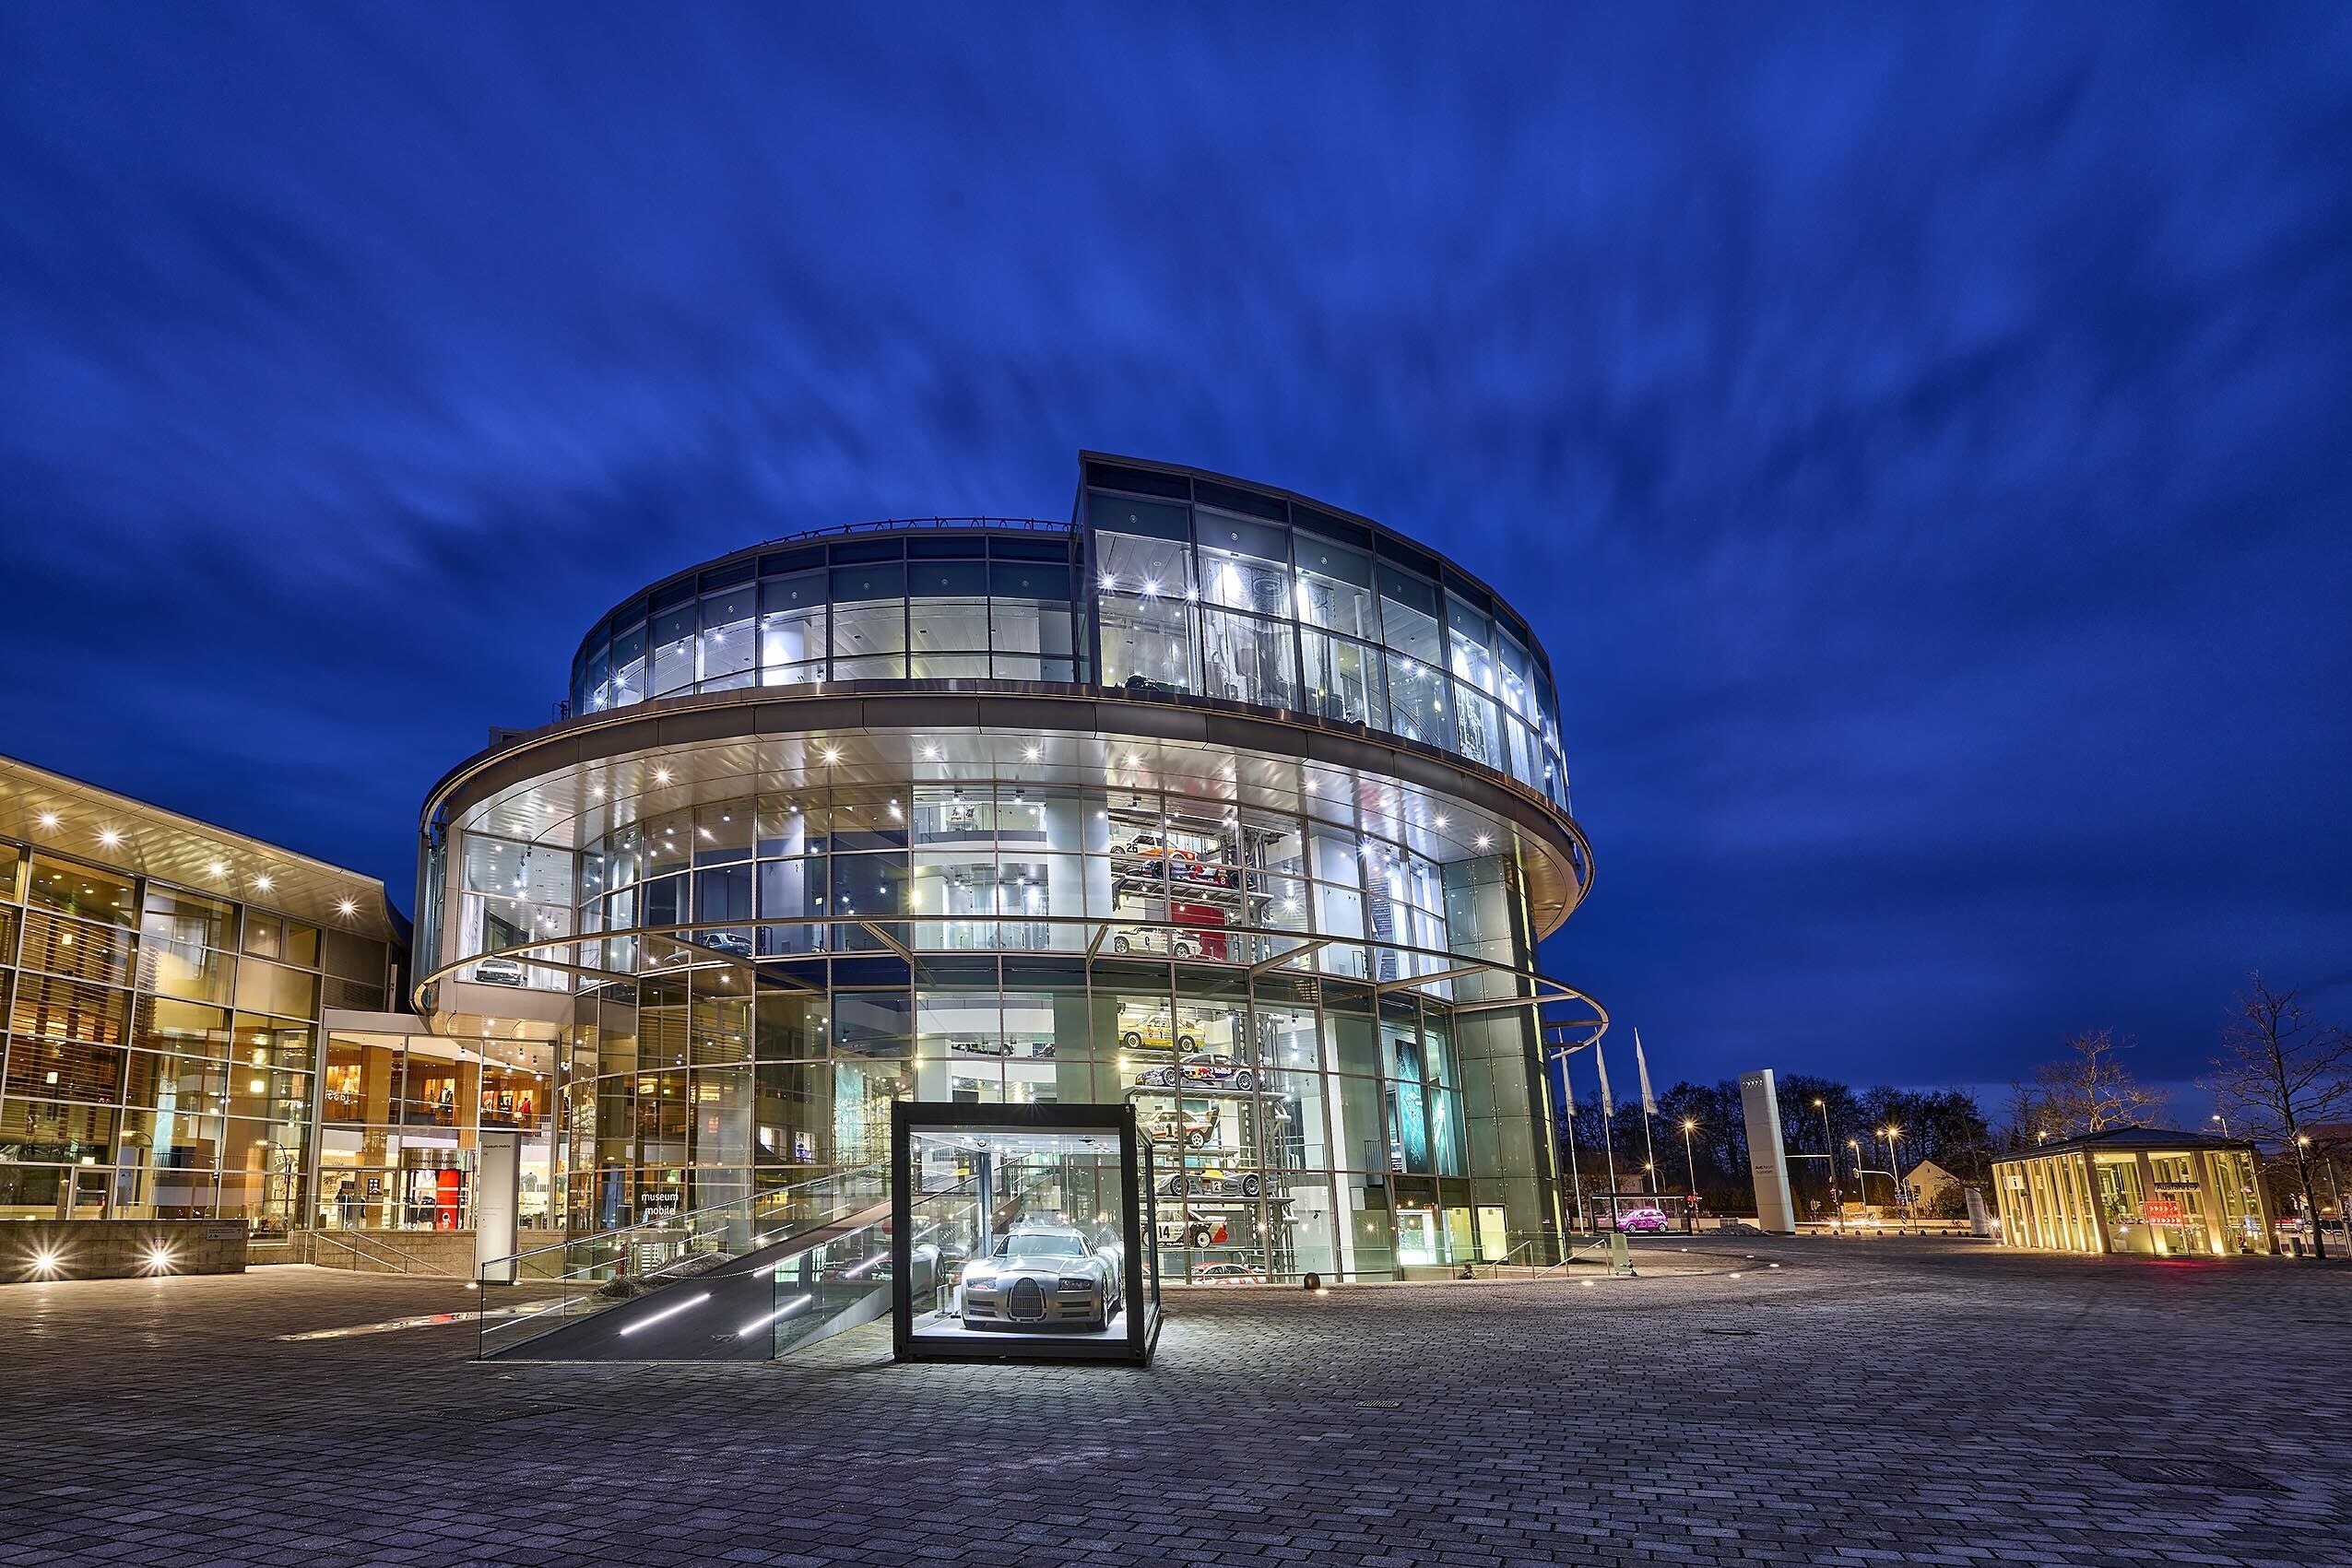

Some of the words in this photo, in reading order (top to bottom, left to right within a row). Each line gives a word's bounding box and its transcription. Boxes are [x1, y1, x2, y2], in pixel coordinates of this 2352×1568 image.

[1127, 843, 1139, 854] 26
[1159, 1031, 1164, 1039] 1
[1165, 1123, 1175, 1138] 1
[1213, 1182, 1220, 1191] 2
[642, 1193, 679, 1201] museum
[644, 1205, 676, 1216] mobile
[1158, 1225, 1171, 1239] 14
